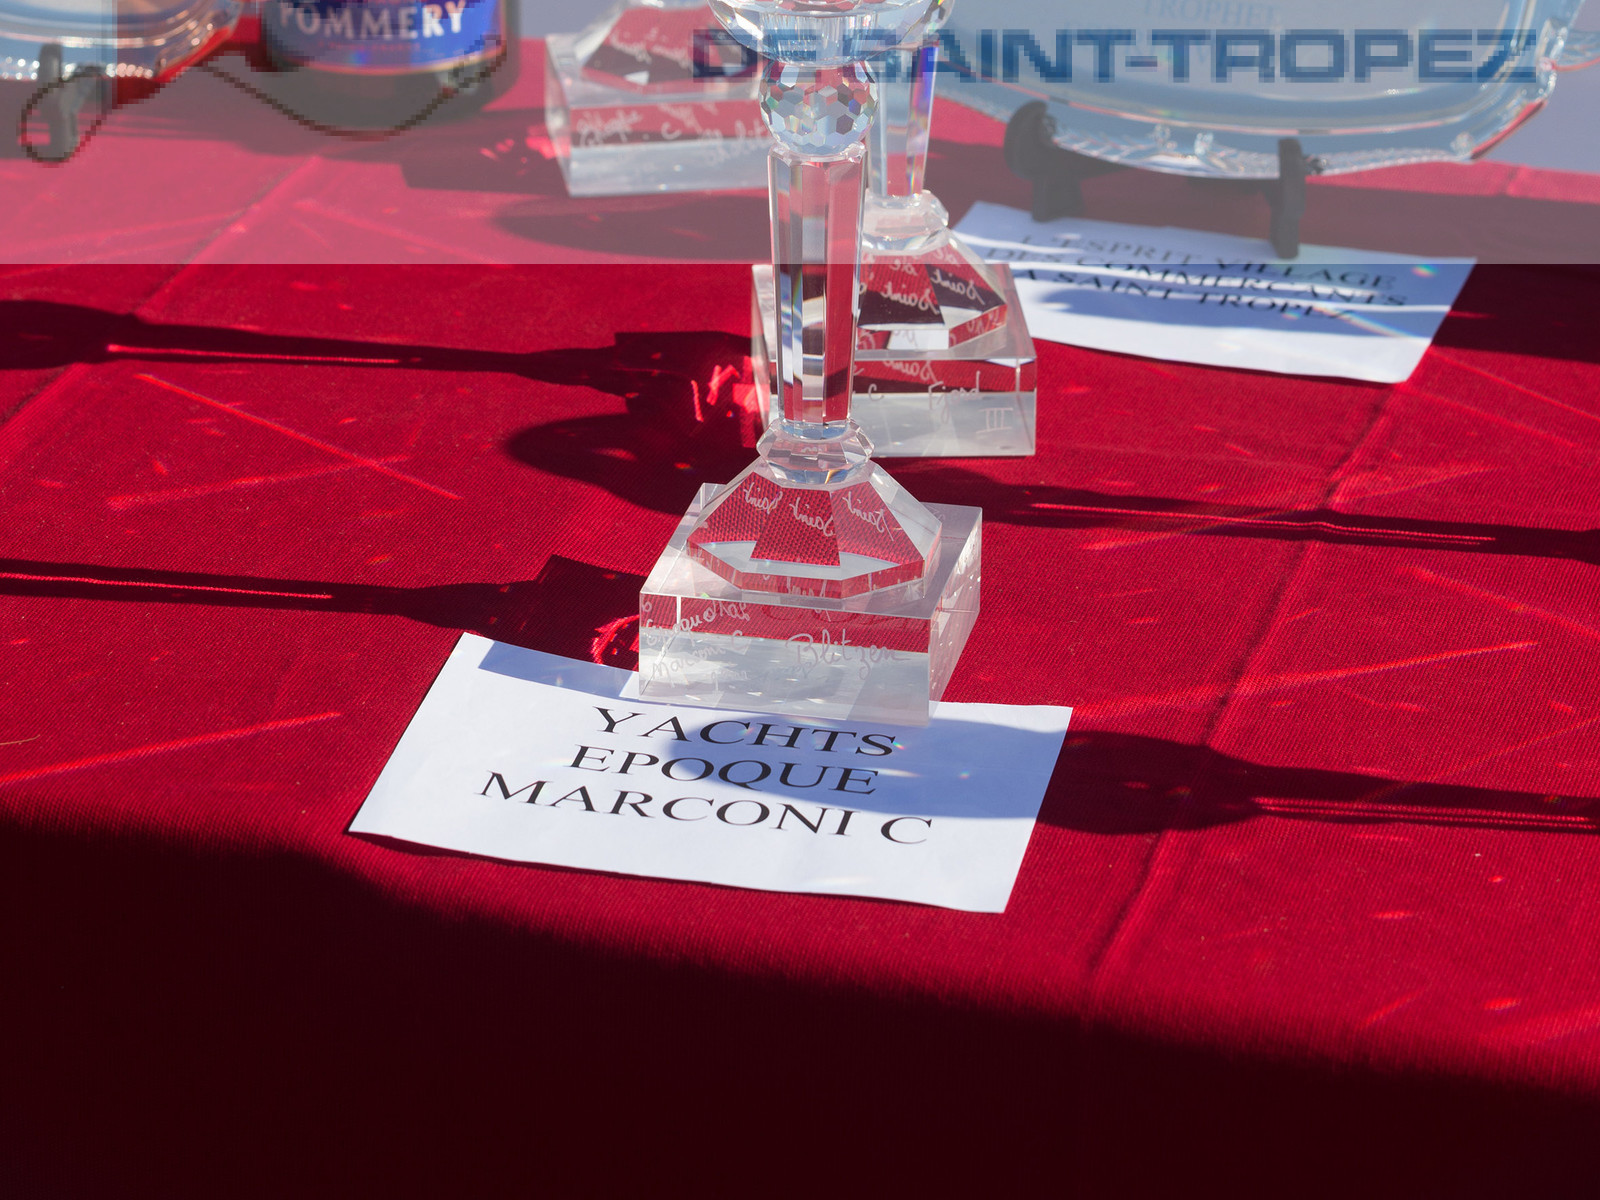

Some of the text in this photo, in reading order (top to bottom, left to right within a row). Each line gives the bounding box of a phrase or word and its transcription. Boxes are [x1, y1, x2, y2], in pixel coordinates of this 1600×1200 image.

[785, 628, 911, 681] Blitzen
[592, 705, 897, 757] YACHTS
[568, 744, 878, 795] EPOQUE
[478, 770, 933, 845] MARCONI C
